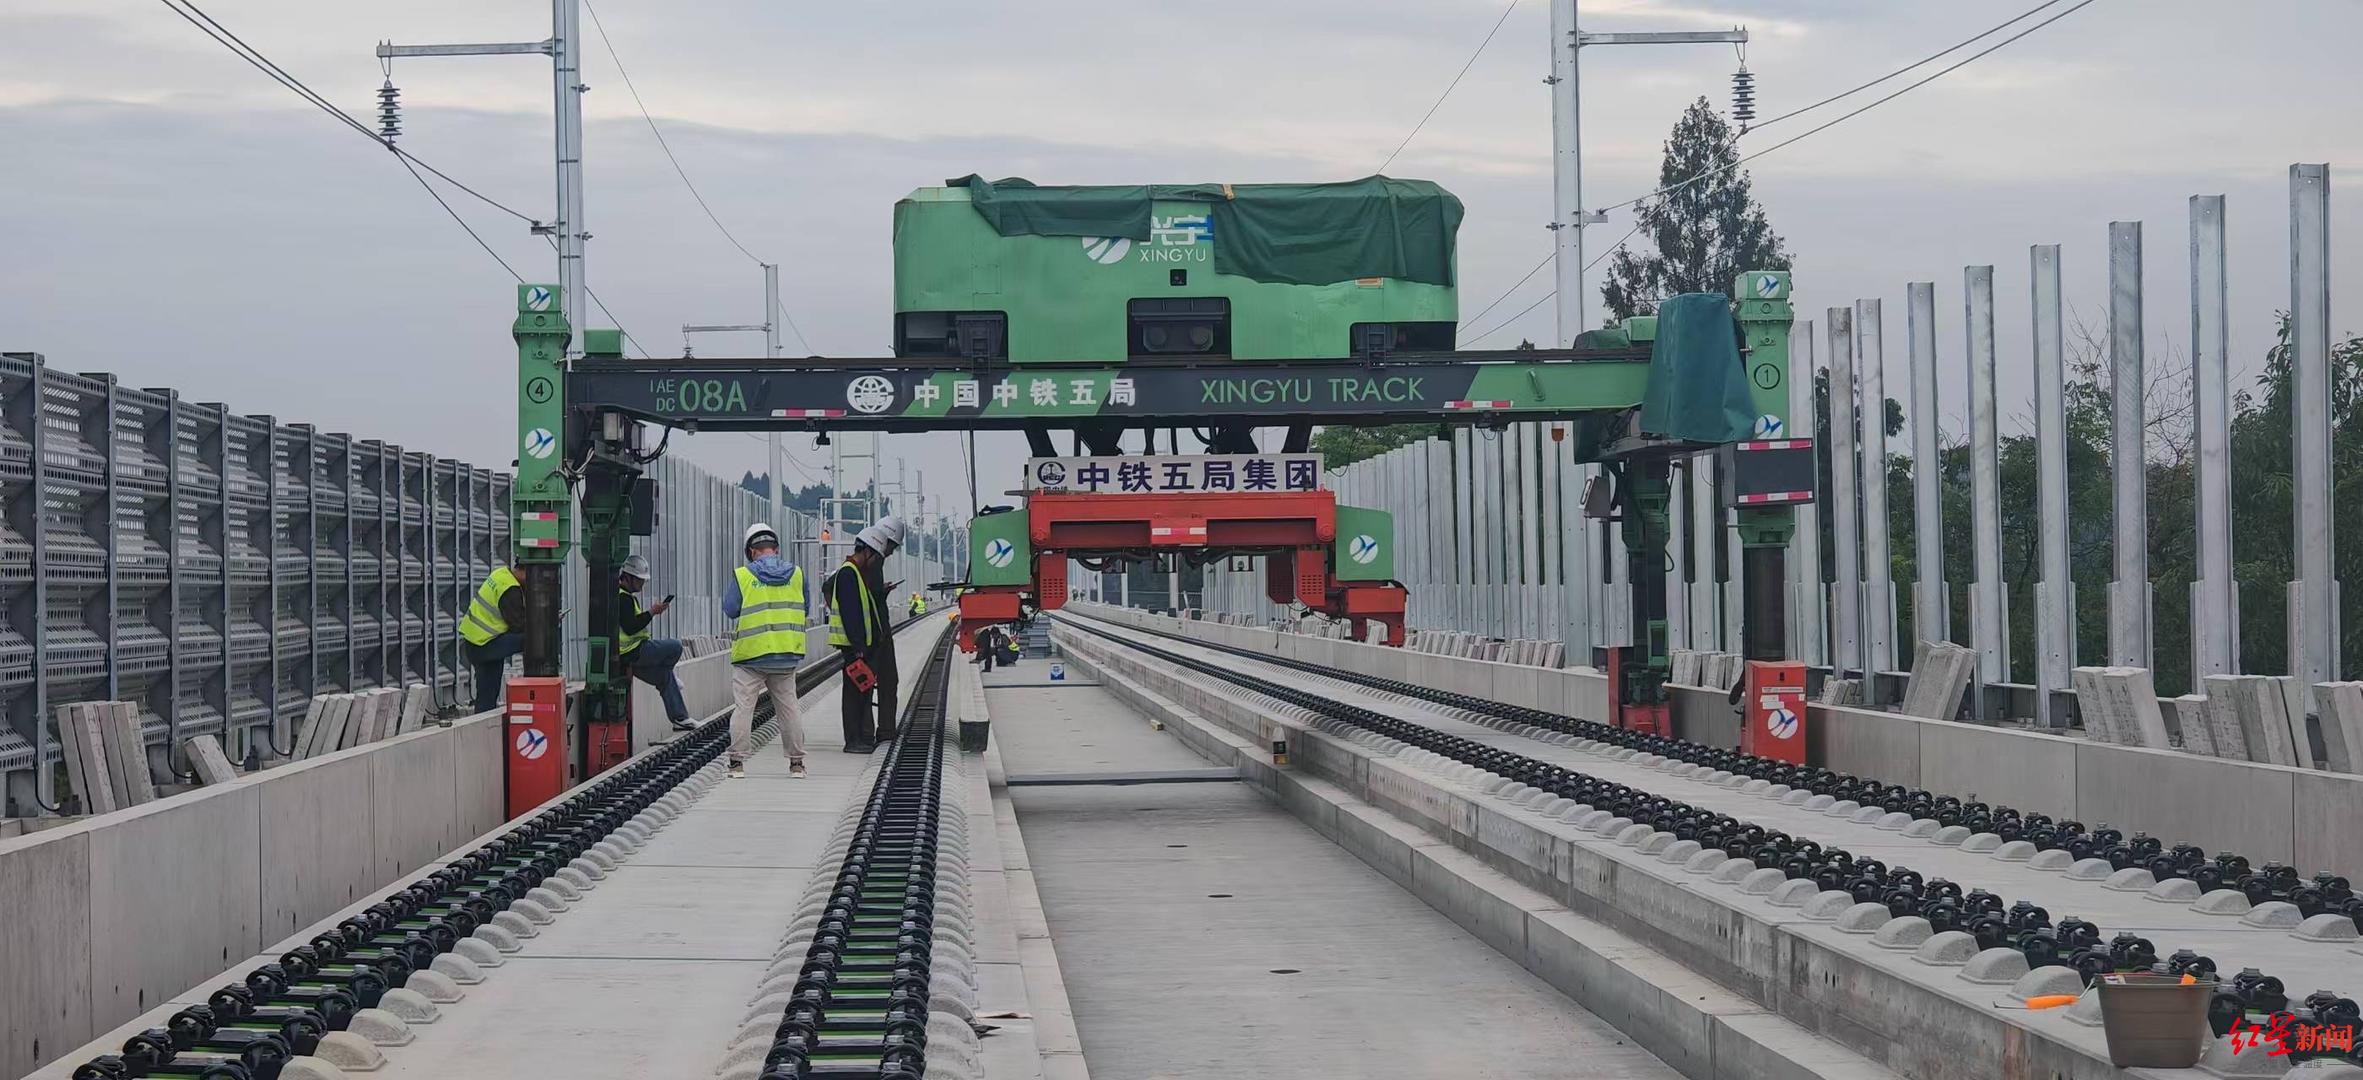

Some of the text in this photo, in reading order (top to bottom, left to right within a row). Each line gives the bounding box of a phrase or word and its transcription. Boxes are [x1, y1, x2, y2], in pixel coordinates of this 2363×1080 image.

[1140, 248, 1206, 262] XINGYU
[656, 397, 676, 412] DC
[679, 379, 747, 412] 08A
[914, 378, 1136, 408] 中国中铁五局
[1201, 377, 1425, 404] XINGYU TRACK
[1077, 459, 1318, 492] 中铁五局集团
